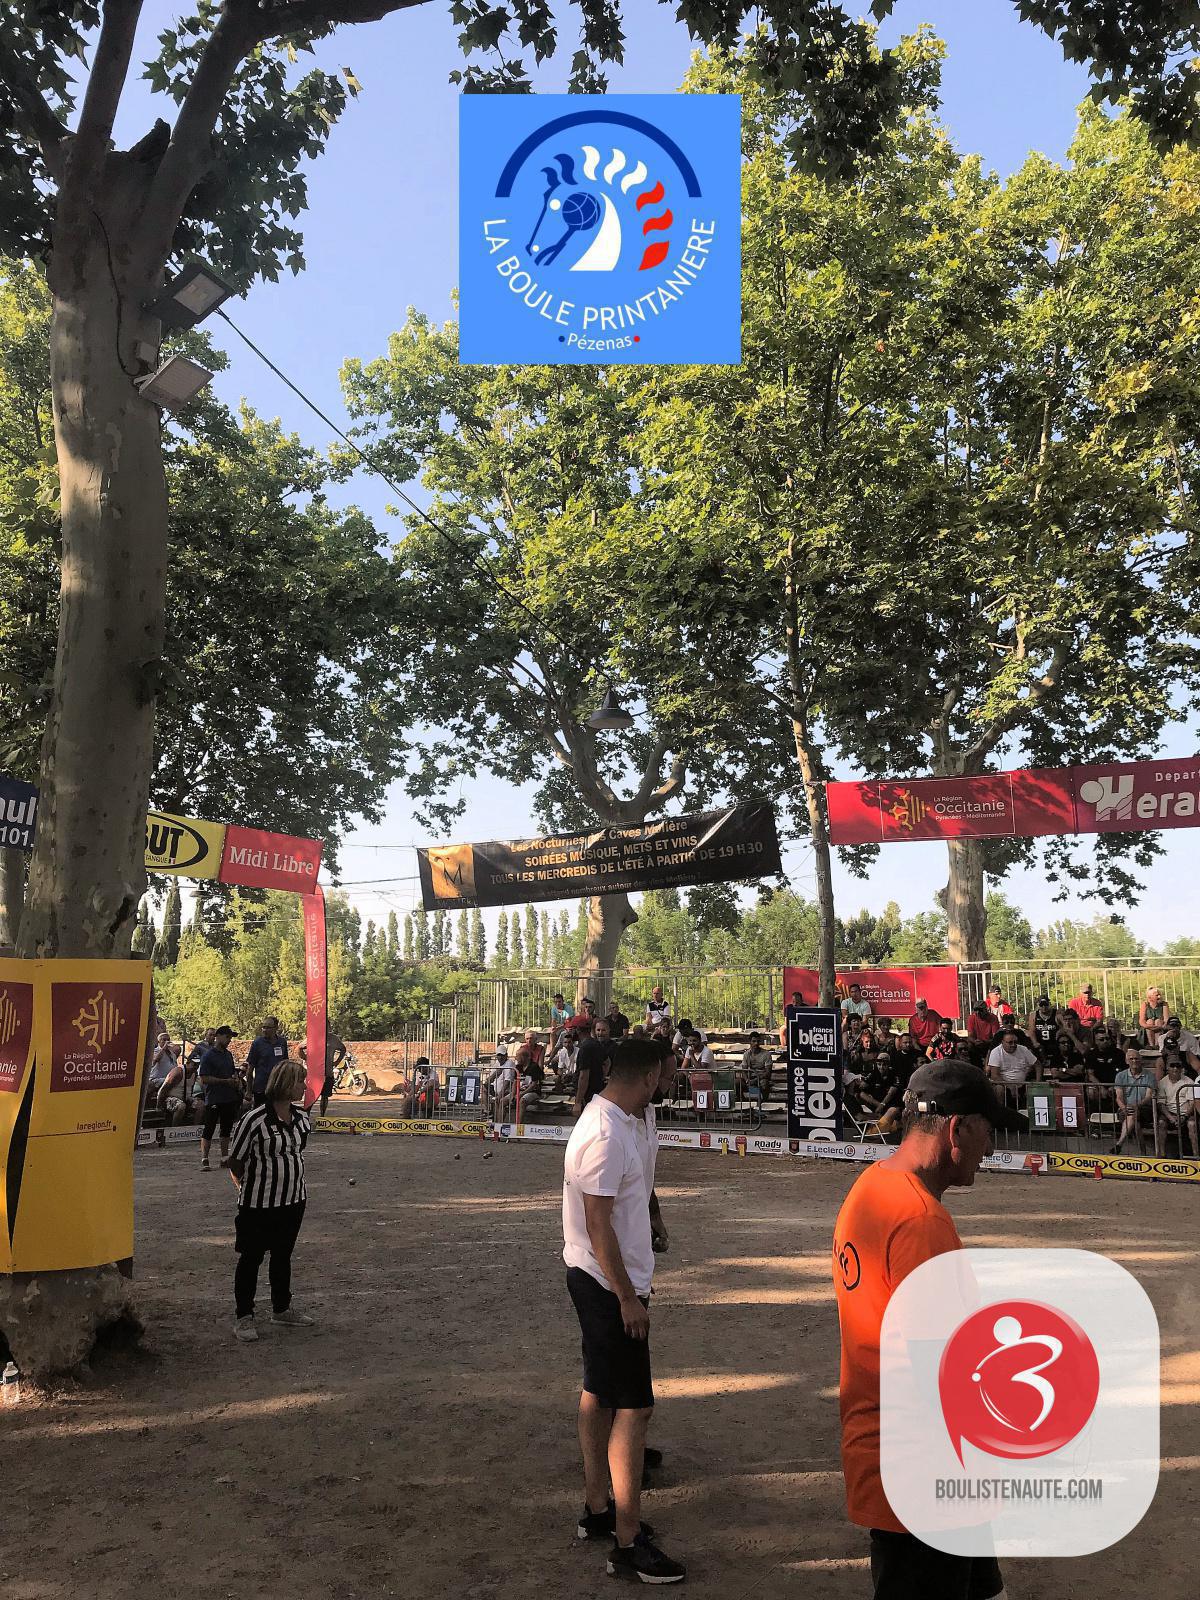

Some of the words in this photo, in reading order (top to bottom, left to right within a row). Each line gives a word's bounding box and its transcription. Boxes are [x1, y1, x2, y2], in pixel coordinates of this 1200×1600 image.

[1156, 769, 1200, 783] Depar
[935, 800, 1005, 814] Occitanie
[530, 836, 585, 850] Nocturnes
[609, 828, 641, 840] Caves
[525, 851, 568, 867] SOIRÉES
[570, 846, 621, 862] MUSIQUE,
[624, 841, 652, 855] METS
[655, 839, 669, 851] ET
[671, 835, 698, 849] VINS
[229, 846, 268, 869] Midi
[272, 853, 314, 875] Libre
[491, 873, 514, 885] TOUS
[516, 871, 535, 883] LES
[537, 864, 597, 881] MERCREDIS
[600, 862, 615, 874] DE
[617, 855, 644, 872] L'ÉTÉ
[647, 854, 655, 868] À
[657, 851, 697, 866] PARTIR
[700, 848, 716, 860] DE
[719, 845, 734, 858] 19
[861, 988, 910, 998] Occitanie
[813, 1026, 833, 1034] france
[1041, 1030, 1050, 1041] 9
[799, 1029, 834, 1046] bleu
[64, 1058, 128, 1074] Occitanie
[449, 1088, 455, 1097] 8
[792, 1066, 805, 1116] france
[698, 1094, 705, 1104] 0
[720, 1094, 727, 1104] 0
[1035, 1111, 1048, 1124] 11
[1065, 1111, 1074, 1123] 8
[806, 1145, 844, 1155] E.Leclerc
[1075, 1158, 1099, 1168] OBUT
[1117, 1161, 1143, 1171] OBUT
[1162, 1164, 1188, 1175] OBUT
